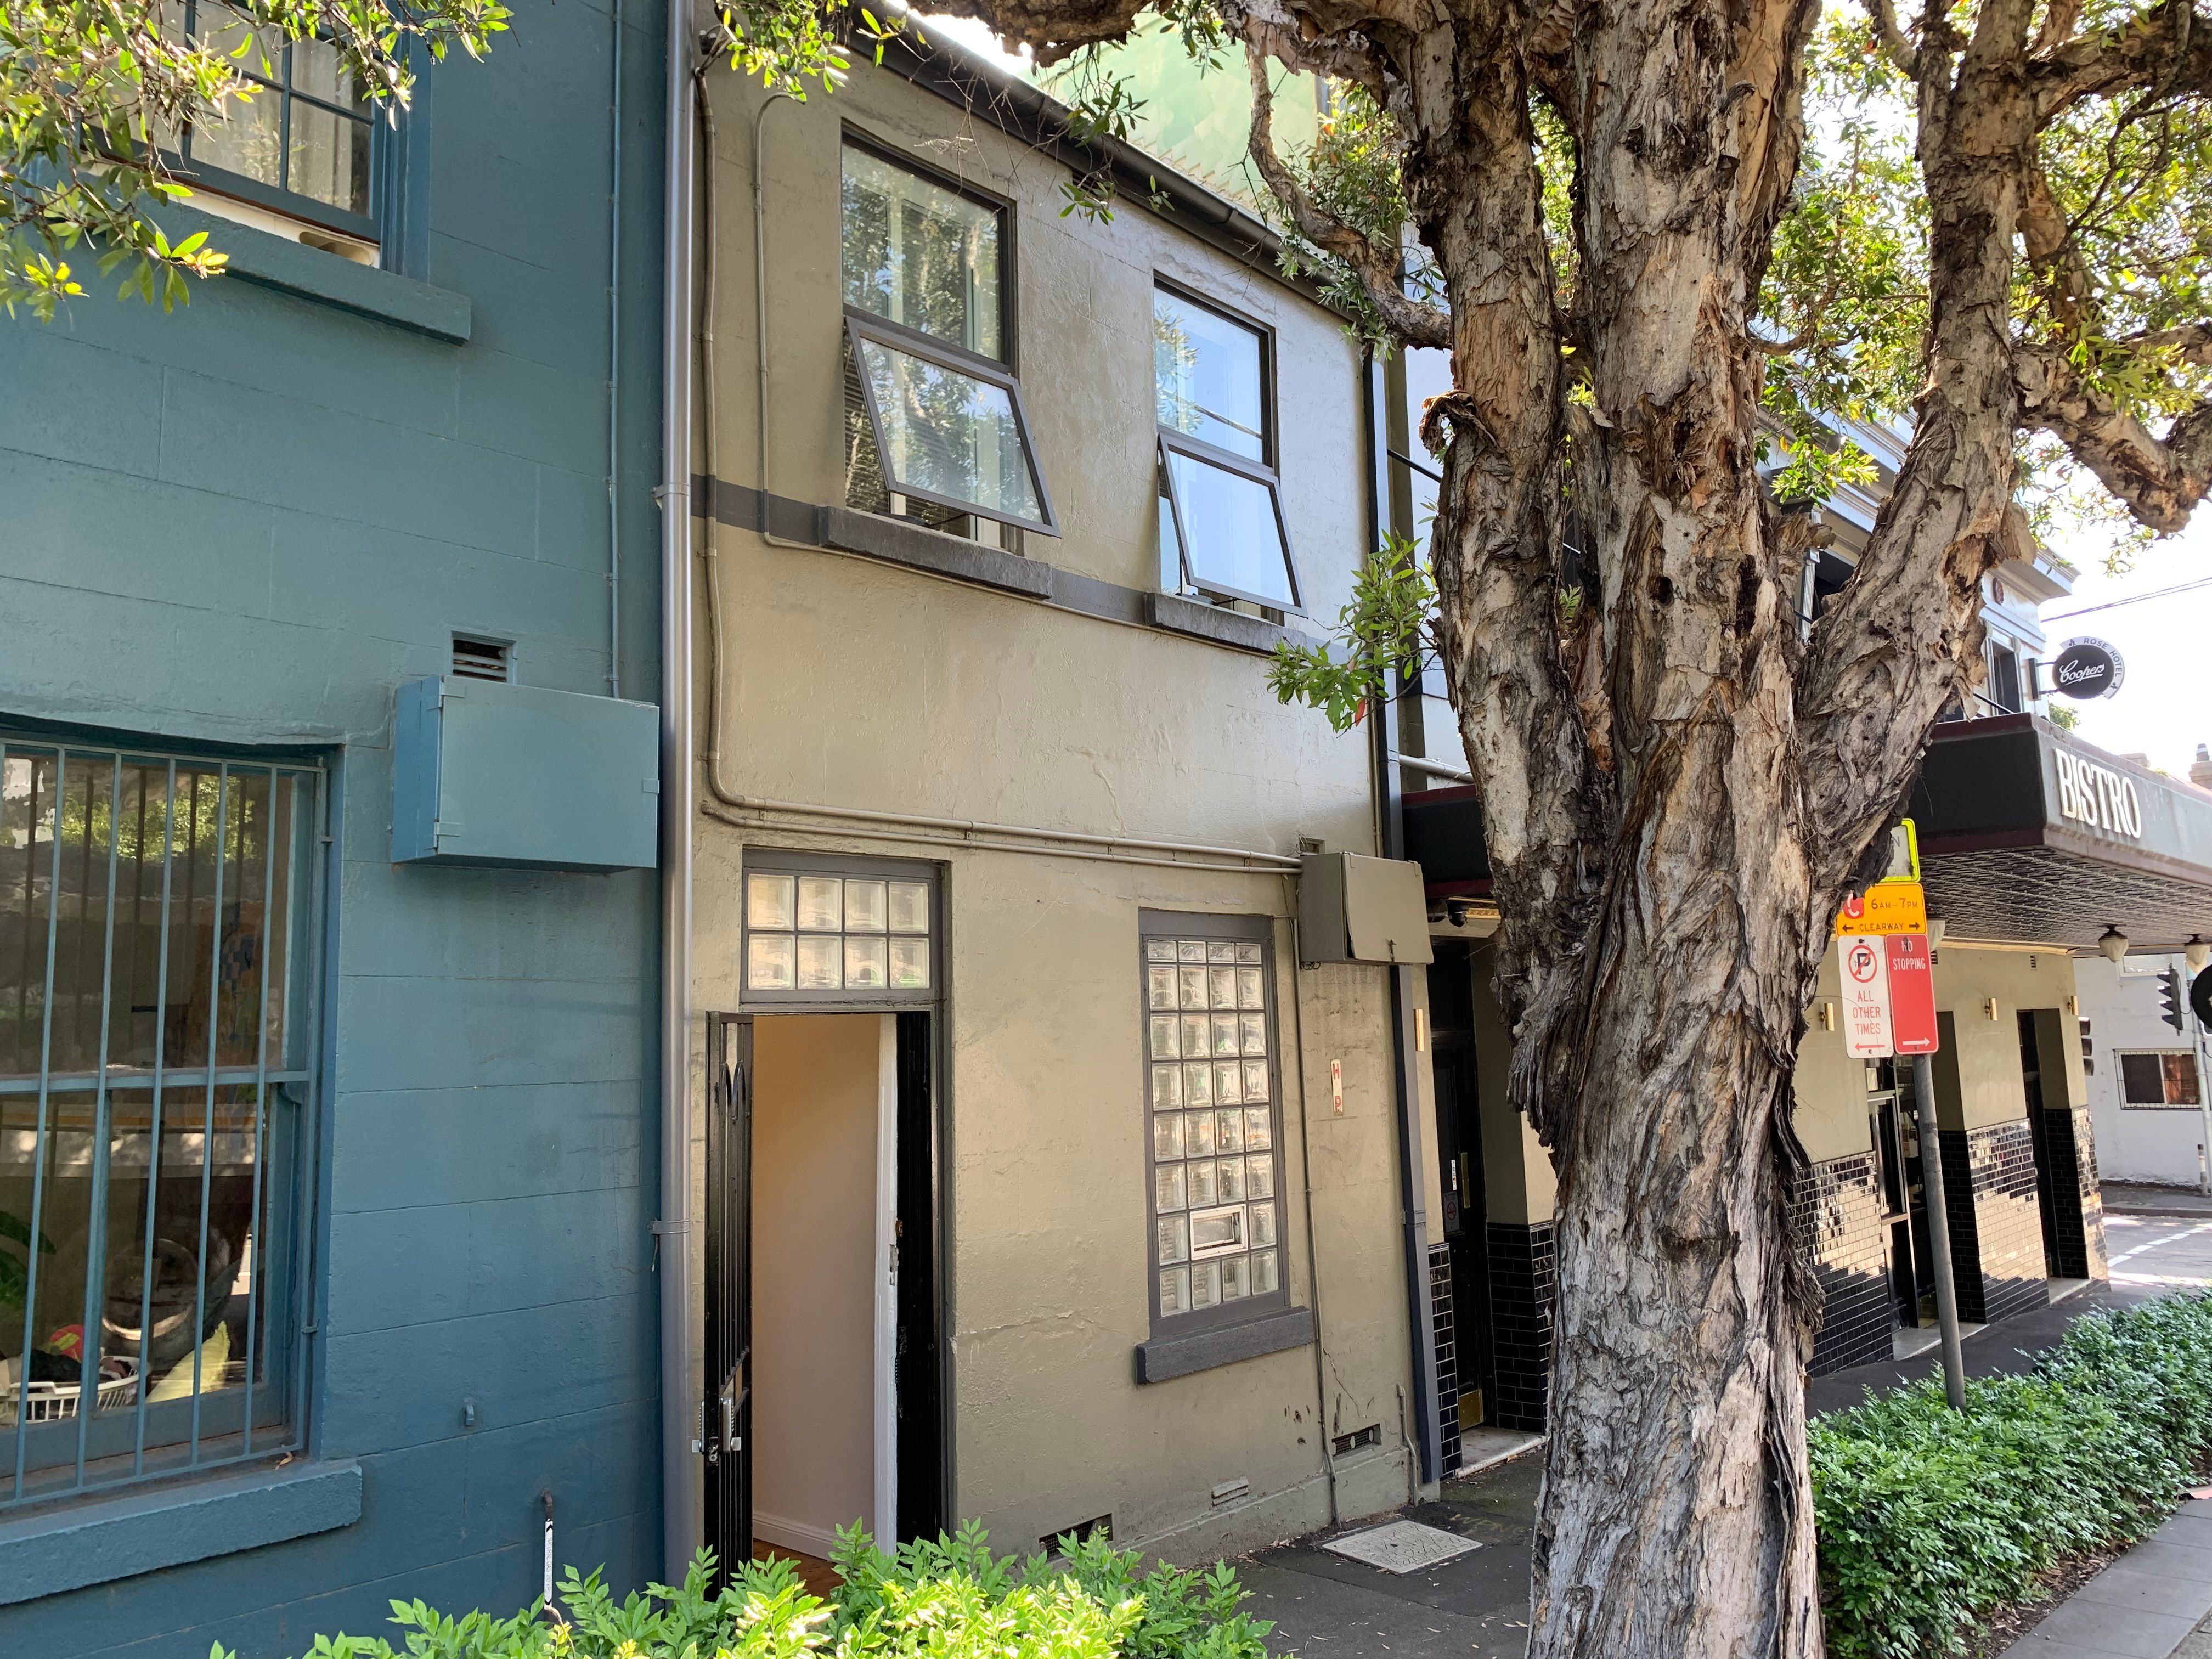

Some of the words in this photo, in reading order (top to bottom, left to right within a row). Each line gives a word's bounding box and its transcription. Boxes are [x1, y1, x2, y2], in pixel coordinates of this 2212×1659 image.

[2084, 637, 2108, 650] ROSE
[2109, 651, 2122, 677] HOTEL
[2059, 659, 2104, 685] Coopers
[2055, 748, 2141, 838] BISTRO
[1859, 922, 1904, 932] CLEARWAY
[1893, 958, 1926, 970] STOPPING
[1858, 991, 1874, 1002] ALL
[1853, 1007, 1881, 1019] OTHER
[1855, 1023, 1881, 1035] TIMES
